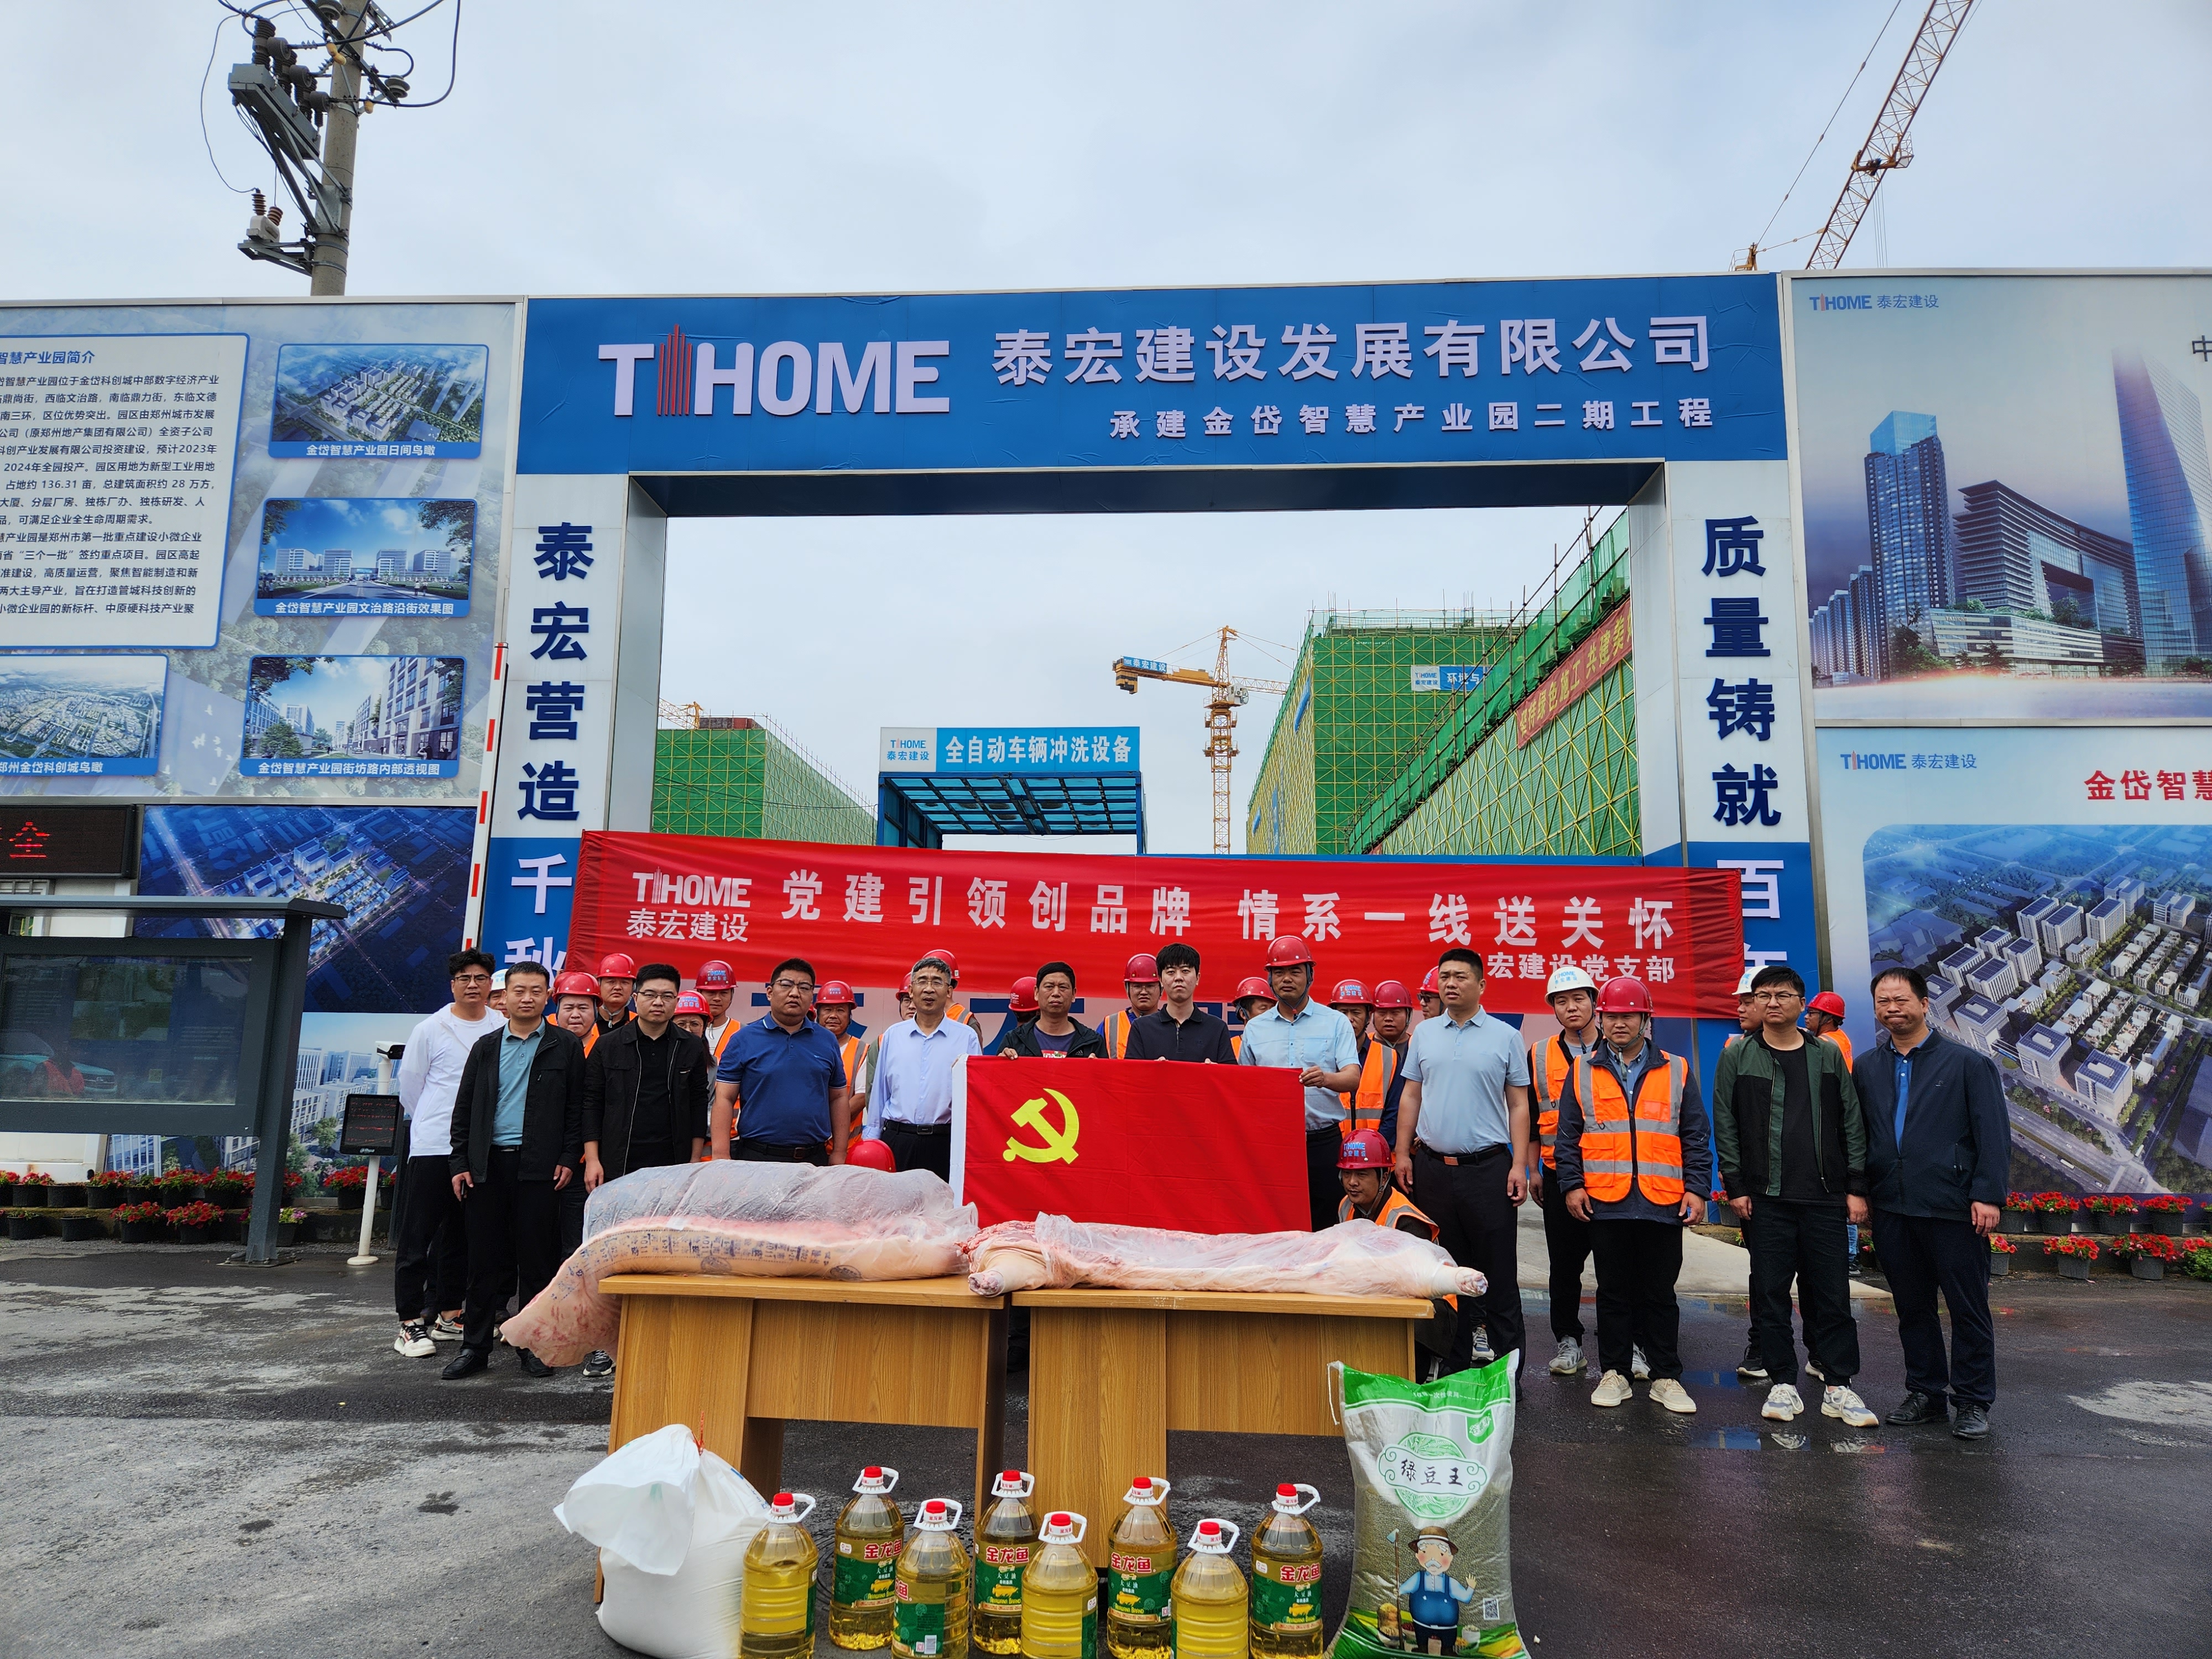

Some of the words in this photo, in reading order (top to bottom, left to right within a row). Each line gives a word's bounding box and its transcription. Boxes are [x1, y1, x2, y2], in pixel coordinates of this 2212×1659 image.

[1876, 294, 1939, 309] 泰宏建设
[993, 316, 1710, 385] 泰宏建设发展有限公司
[0, 392, 217, 404] 鼎尚街，西临文治路，南临鼎力街，东临文德
[1109, 397, 1713, 439] 承建金岱智慧产业园二期工程
[305, 444, 436, 457] 金岱智慧产业园日间鸟瞰
[4, 461, 215, 473] 2024年全园投产。园区用地为新型工业用地
[6, 480, 37, 491] 占地约
[41, 479, 77, 489] 136.31
[82, 479, 168, 491] 亩，总建筑面积约
[171, 479, 186, 488] 28
[189, 479, 215, 491] 万方，
[0, 497, 205, 508] 大厦、分层厂房、独栋厂办、独栋研发、人
[0, 549, 200, 561] 省“三个一批”签约重点项目。园区高起
[274, 602, 455, 615] 金岱智慧产业园文治路沿街效果图
[1133, 658, 1166, 672] 泰宏建设
[886, 750, 930, 761] 泰宏建设
[945, 735, 1132, 764] 全自动车辆冲洗设备
[257, 761, 441, 776] 金岱智慧产业园街坊路内部透视图
[1911, 753, 1978, 769] 泰宏建设
[2084, 769, 2212, 801] 金岱智慧
[780, 868, 1192, 937] 党建引领创品牌
[1237, 888, 1674, 950] 情系一线送关怀
[625, 907, 749, 942] 泰宏建设
[1480, 951, 1675, 984] 宏建设党支部
[1400, 1457, 1464, 1487] 绿豆王
[864, 1538, 902, 1559] 金龙鱼
[985, 1546, 1029, 1564] 金龙鱼
[1111, 1552, 1151, 1573] 金龙鱼
[1280, 1562, 1321, 1582] 金龙鱼
